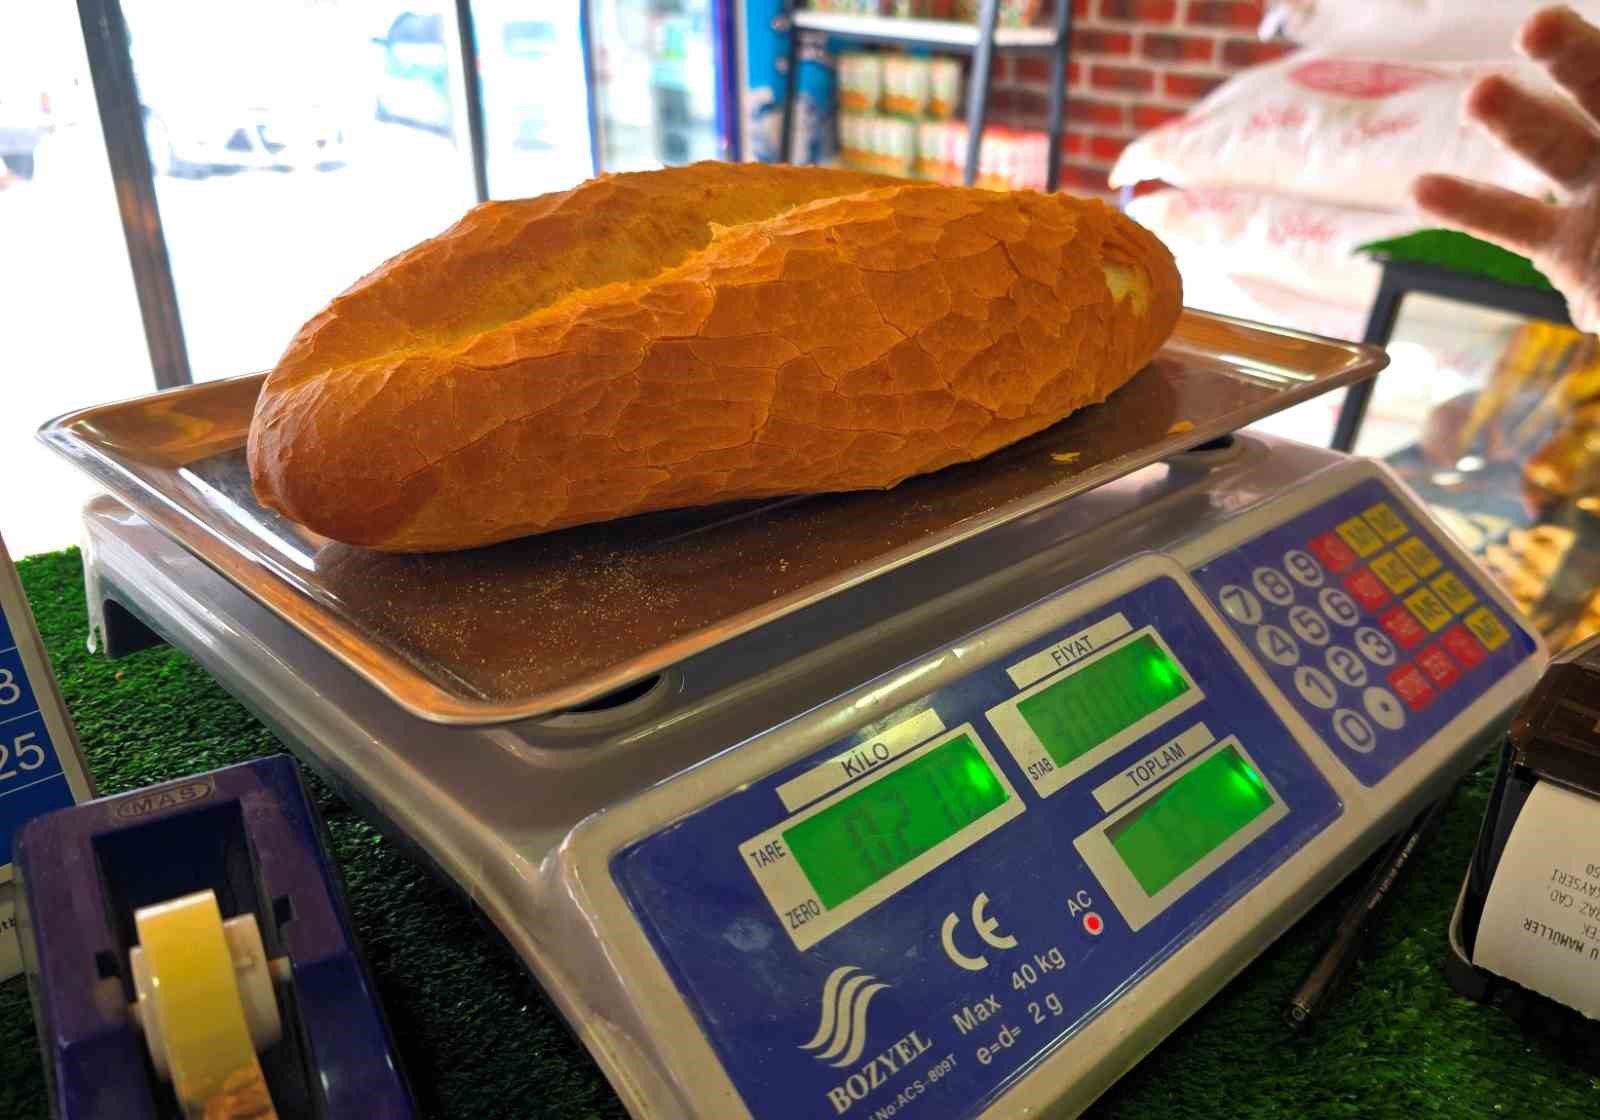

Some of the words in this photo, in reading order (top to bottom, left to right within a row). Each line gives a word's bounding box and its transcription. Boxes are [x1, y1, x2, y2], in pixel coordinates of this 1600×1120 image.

[1222, 588, 1252, 618] 7
[1259, 571, 1289, 599] 8
[1291, 553, 1318, 581] 9
[1269, 629, 1297, 657] 4
[1293, 610, 1325, 640] 5
[1326, 592, 1355, 620] 6
[1304, 671, 1332, 699] 1
[1333, 651, 1364, 682] 2
[1361, 631, 1391, 659] 3
[1341, 714, 1371, 746] 0
[1027, 758, 1054, 781] STAB
[1126, 742, 1186, 787] TOPLAM
[750, 840, 786, 869] TARE
[784, 899, 820, 929] ZERO
[1067, 889, 1092, 918] AC
[941, 892, 1018, 971] CE
[952, 994, 1002, 1036] Max
[1011, 963, 1039, 991] 40
[1034, 946, 1067, 974] kg
[1027, 1001, 1047, 1025] 2
[1045, 992, 1064, 1016] g
[825, 1029, 933, 1115] BOZYEL
